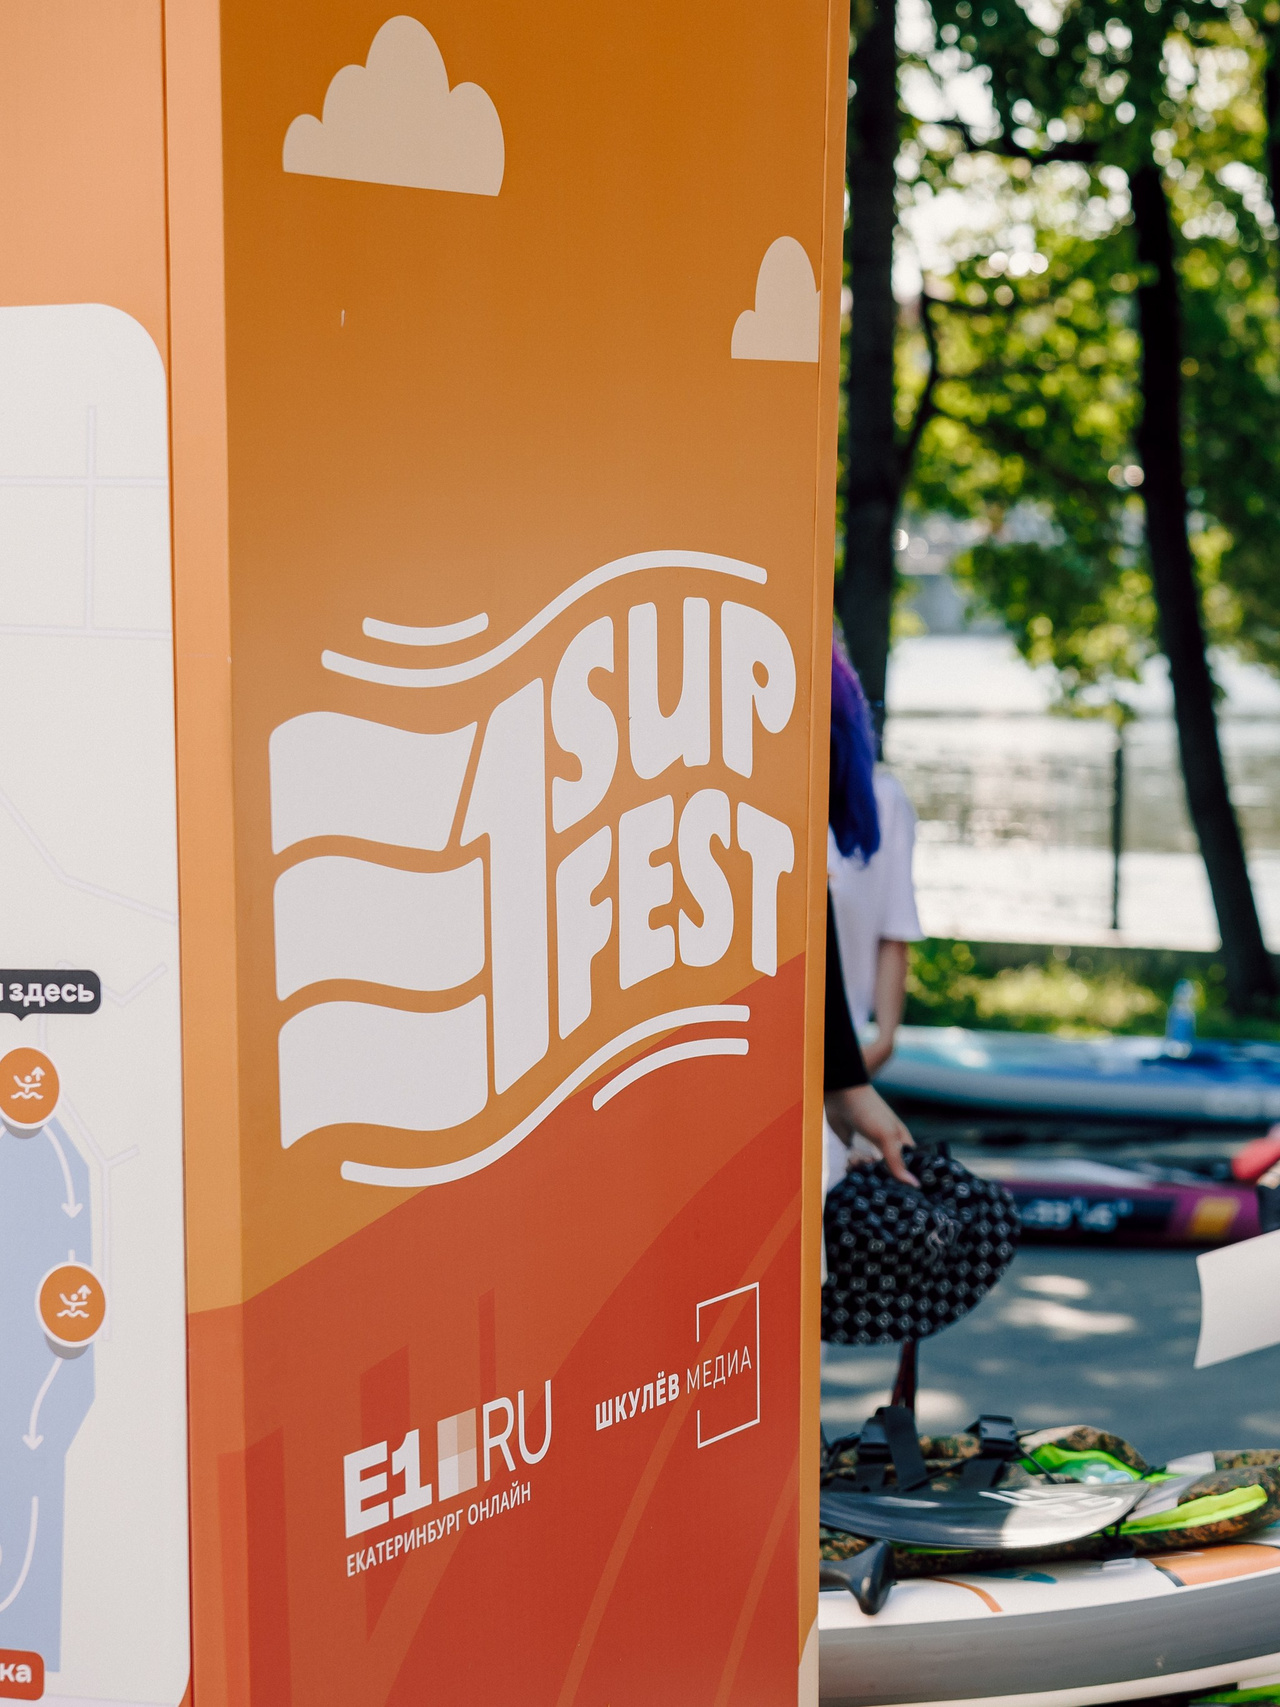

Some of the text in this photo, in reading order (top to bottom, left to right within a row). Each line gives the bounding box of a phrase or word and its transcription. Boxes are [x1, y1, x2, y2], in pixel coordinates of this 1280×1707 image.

[551, 597, 797, 834] SUP
[556, 788, 795, 1040] FEST
[8, 982, 95, 1008] здесь
[595, 1345, 752, 1432] ШКУЛЁВ МЕДИА
[346, 1480, 531, 1578] ЕКАТЕРИНБУРГ ОНЛАЙН
